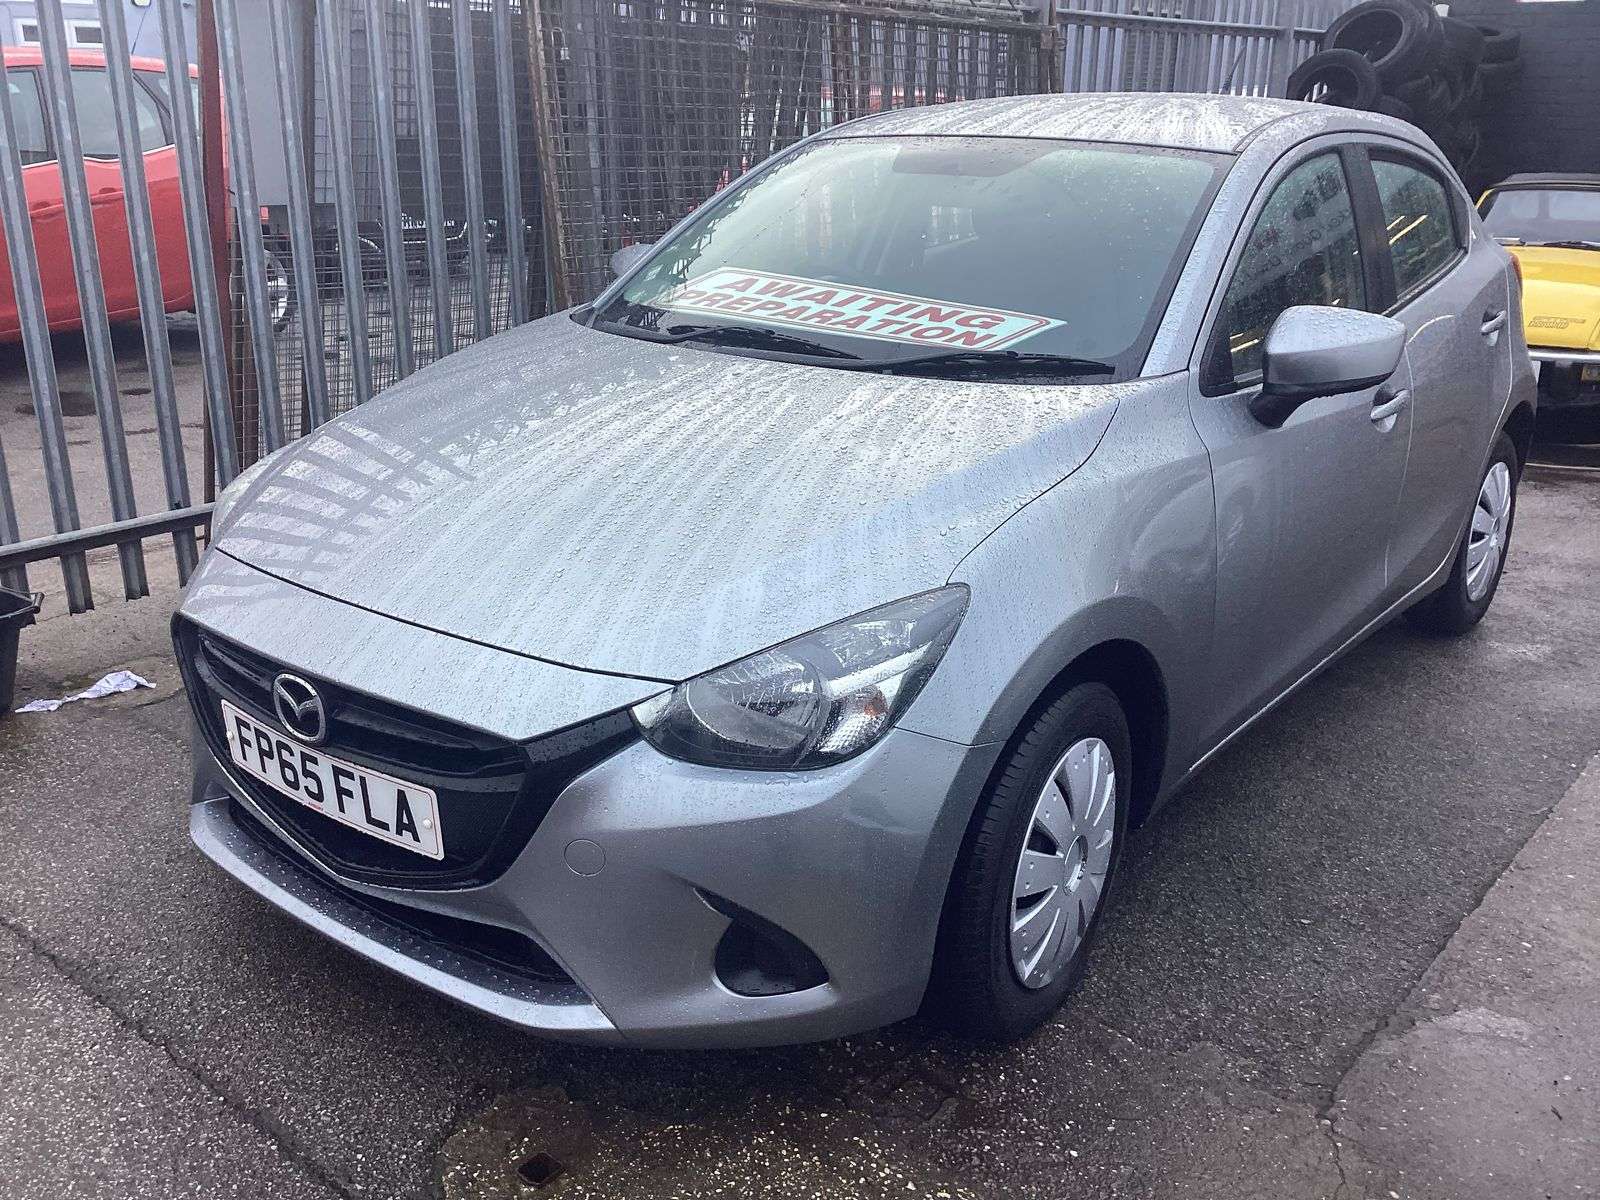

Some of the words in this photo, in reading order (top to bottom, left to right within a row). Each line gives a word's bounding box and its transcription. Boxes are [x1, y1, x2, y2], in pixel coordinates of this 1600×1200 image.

[673, 290, 997, 346] PREPARATION
[714, 278, 1005, 329] AWAITING
[235, 715, 325, 803] FP65
[331, 764, 421, 843] FLA
